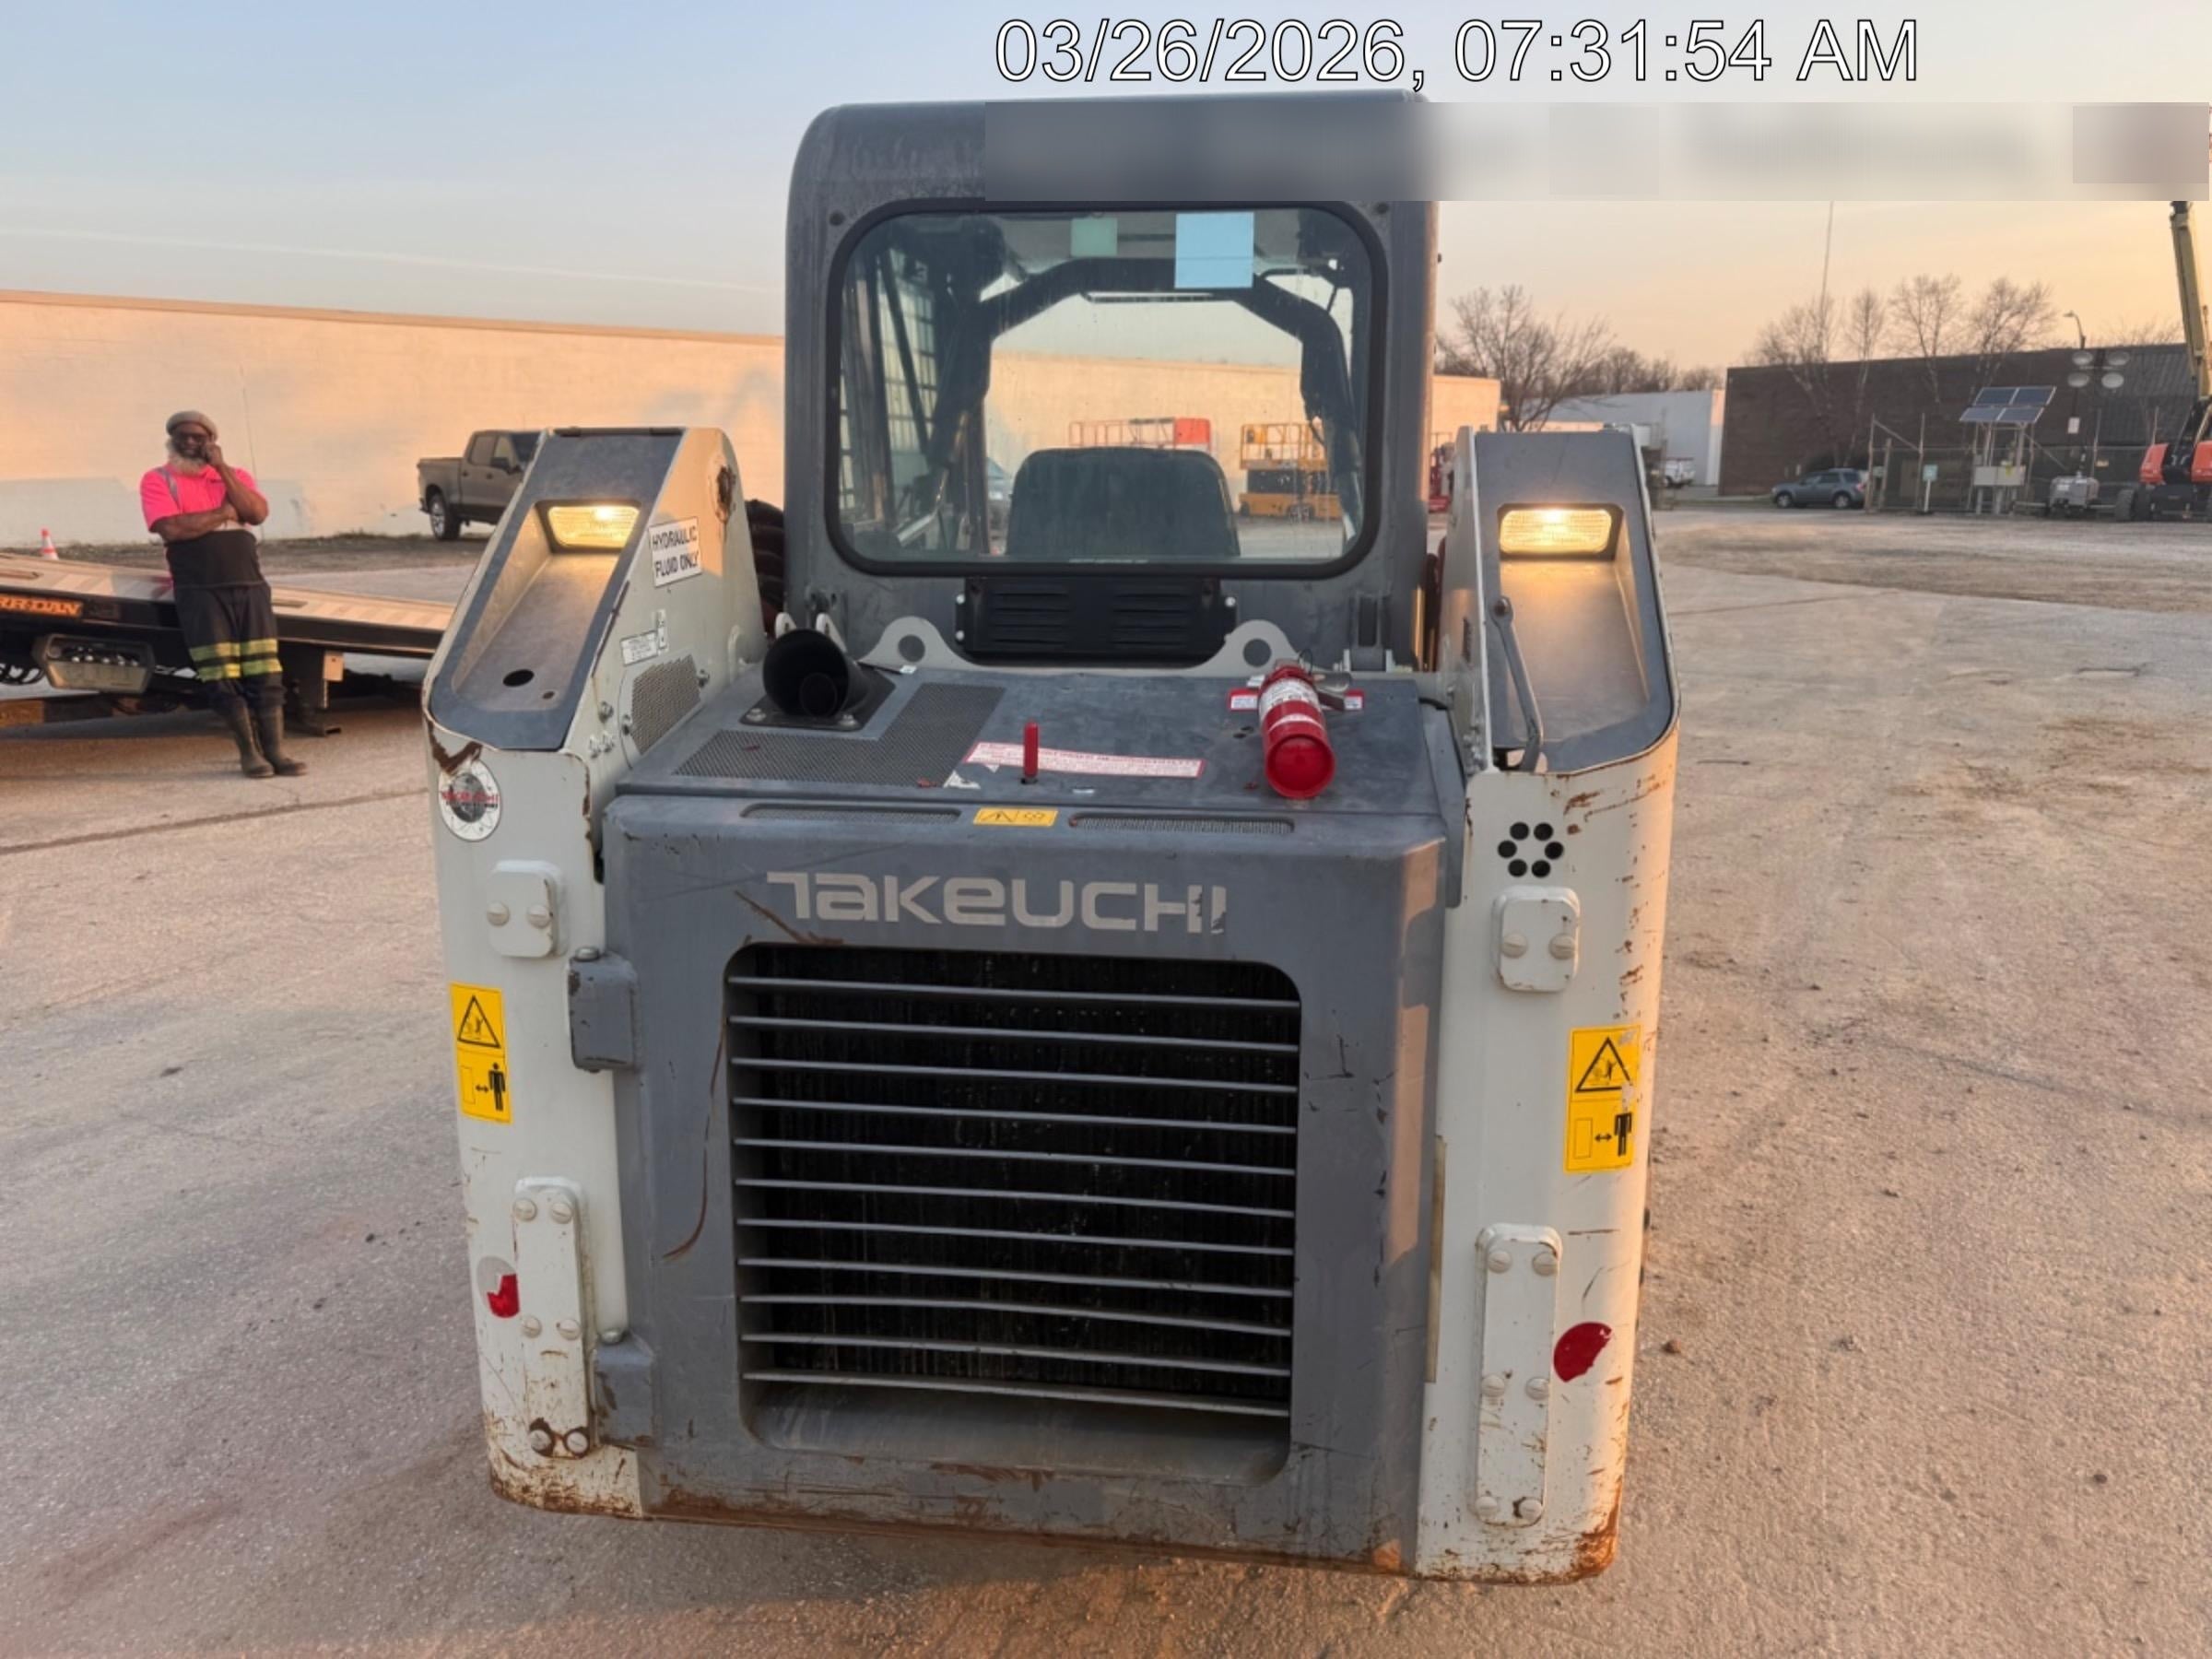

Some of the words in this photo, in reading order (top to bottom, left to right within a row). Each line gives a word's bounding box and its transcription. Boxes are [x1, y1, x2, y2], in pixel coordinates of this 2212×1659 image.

[652, 525, 697, 550] HYDRAULIC
[655, 556, 679, 578] FLUID
[679, 549, 700, 571] ONLY
